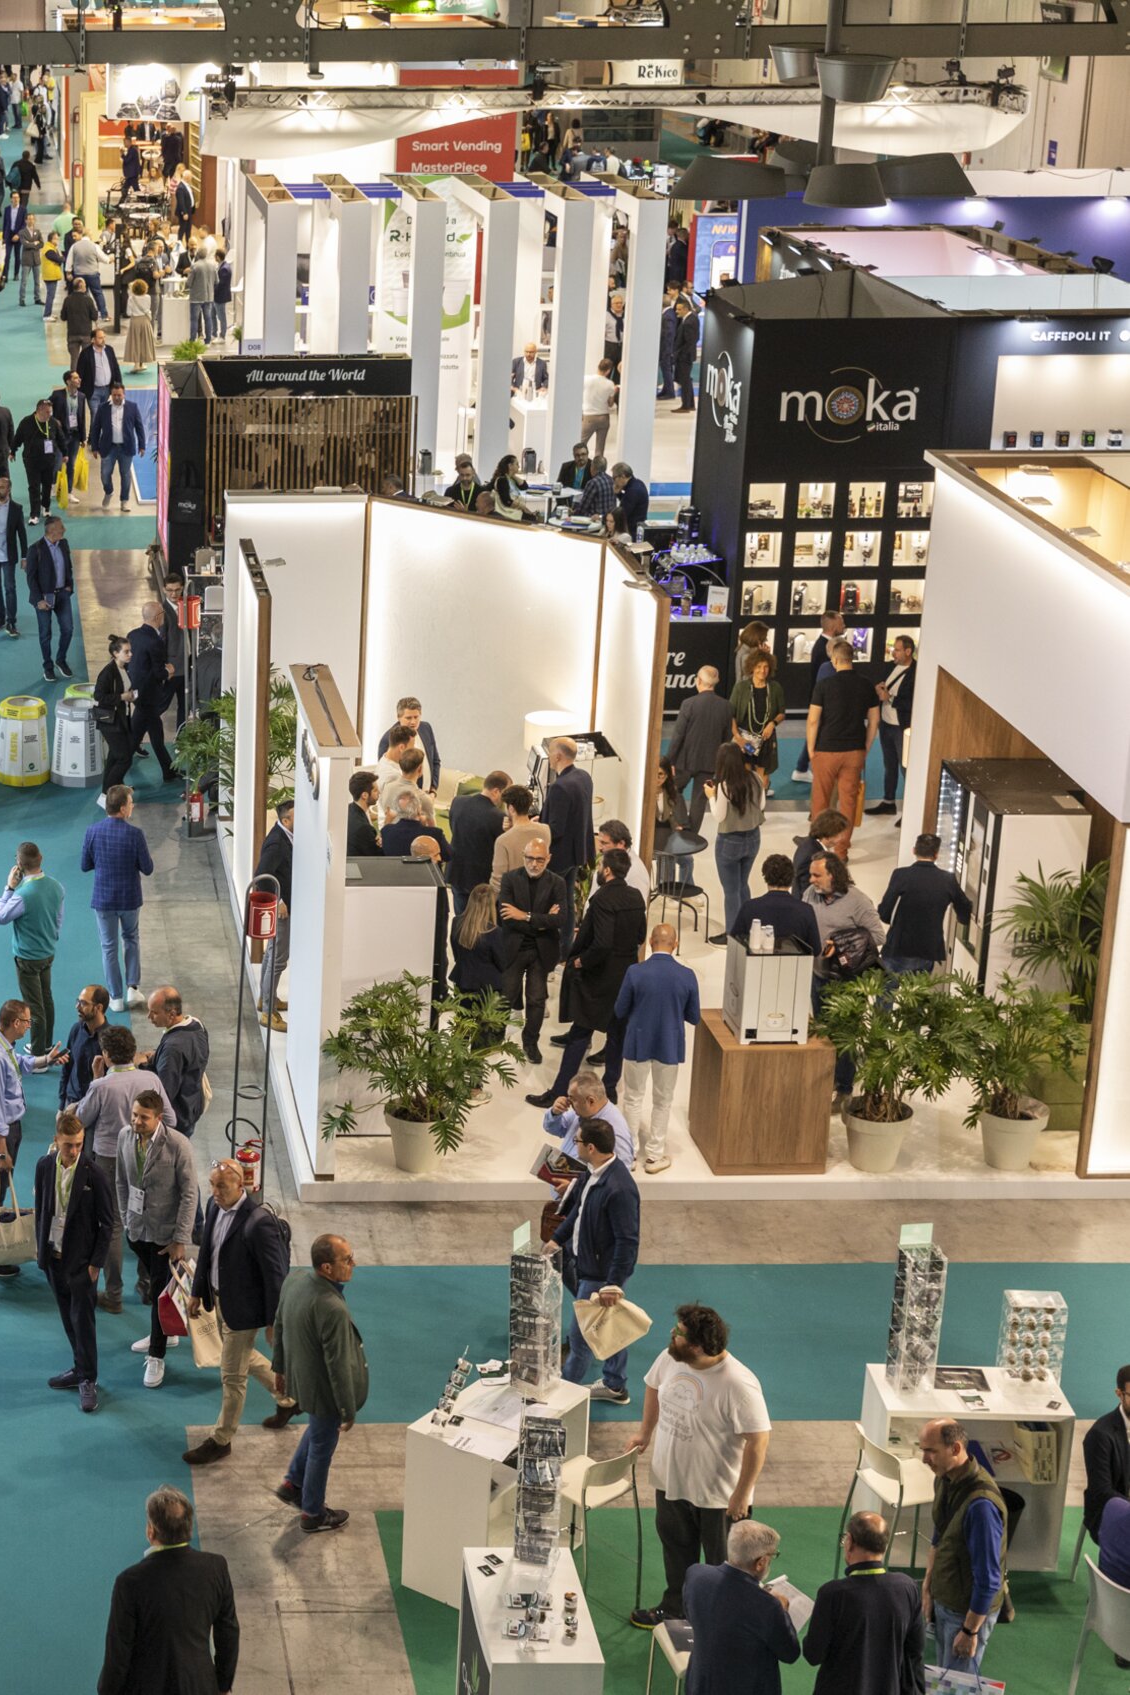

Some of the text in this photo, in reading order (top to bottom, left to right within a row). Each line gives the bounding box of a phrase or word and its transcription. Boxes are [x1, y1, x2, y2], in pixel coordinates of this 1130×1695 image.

[411, 140, 502, 153] Smart Vending
[411, 162, 487, 173] MasterPiece
[1030, 331, 1096, 342] CAFFEPOLI
[246, 368, 366, 383] All around the World
[779, 377, 918, 425] moka
[875, 421, 900, 432] italia
